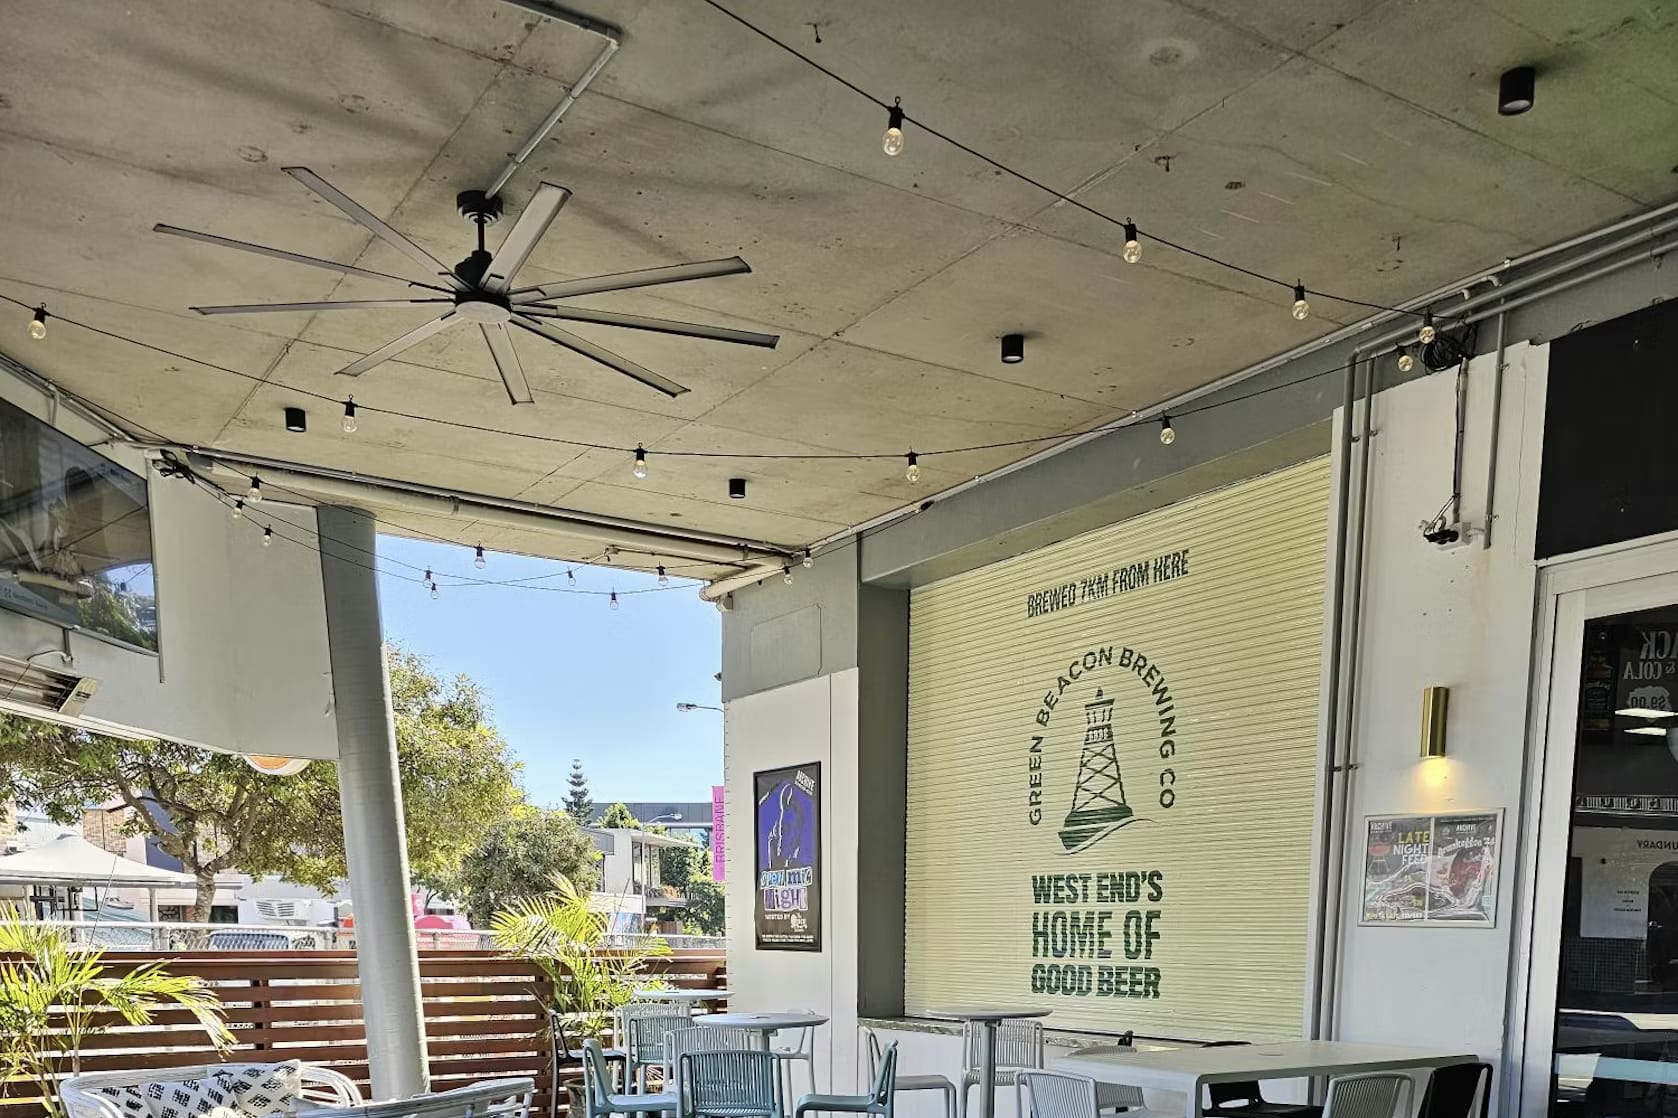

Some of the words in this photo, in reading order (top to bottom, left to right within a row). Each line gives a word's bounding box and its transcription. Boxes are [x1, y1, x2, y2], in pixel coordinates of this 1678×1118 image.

[1027, 583, 1077, 618] BREWED
[1080, 573, 1109, 600] 7KM
[1112, 561, 1149, 594] FROM
[1153, 549, 1190, 583] HERE
[1036, 646, 1113, 727] BEACON
[1119, 647, 1176, 758] BREWING
[1029, 736, 1044, 826] GREEN
[1159, 768, 1175, 808] CO
[714, 796, 725, 863] BRISBANE
[1393, 843, 1429, 856] NIGHT
[1398, 831, 1430, 844] LATE
[1031, 873, 1092, 904] WEST
[1096, 870, 1163, 902] END'S
[1032, 910, 1112, 958] HOME
[1123, 910, 1161, 959] OF
[1031, 963, 1092, 996] GOOD
[1096, 965, 1161, 999] BEER
